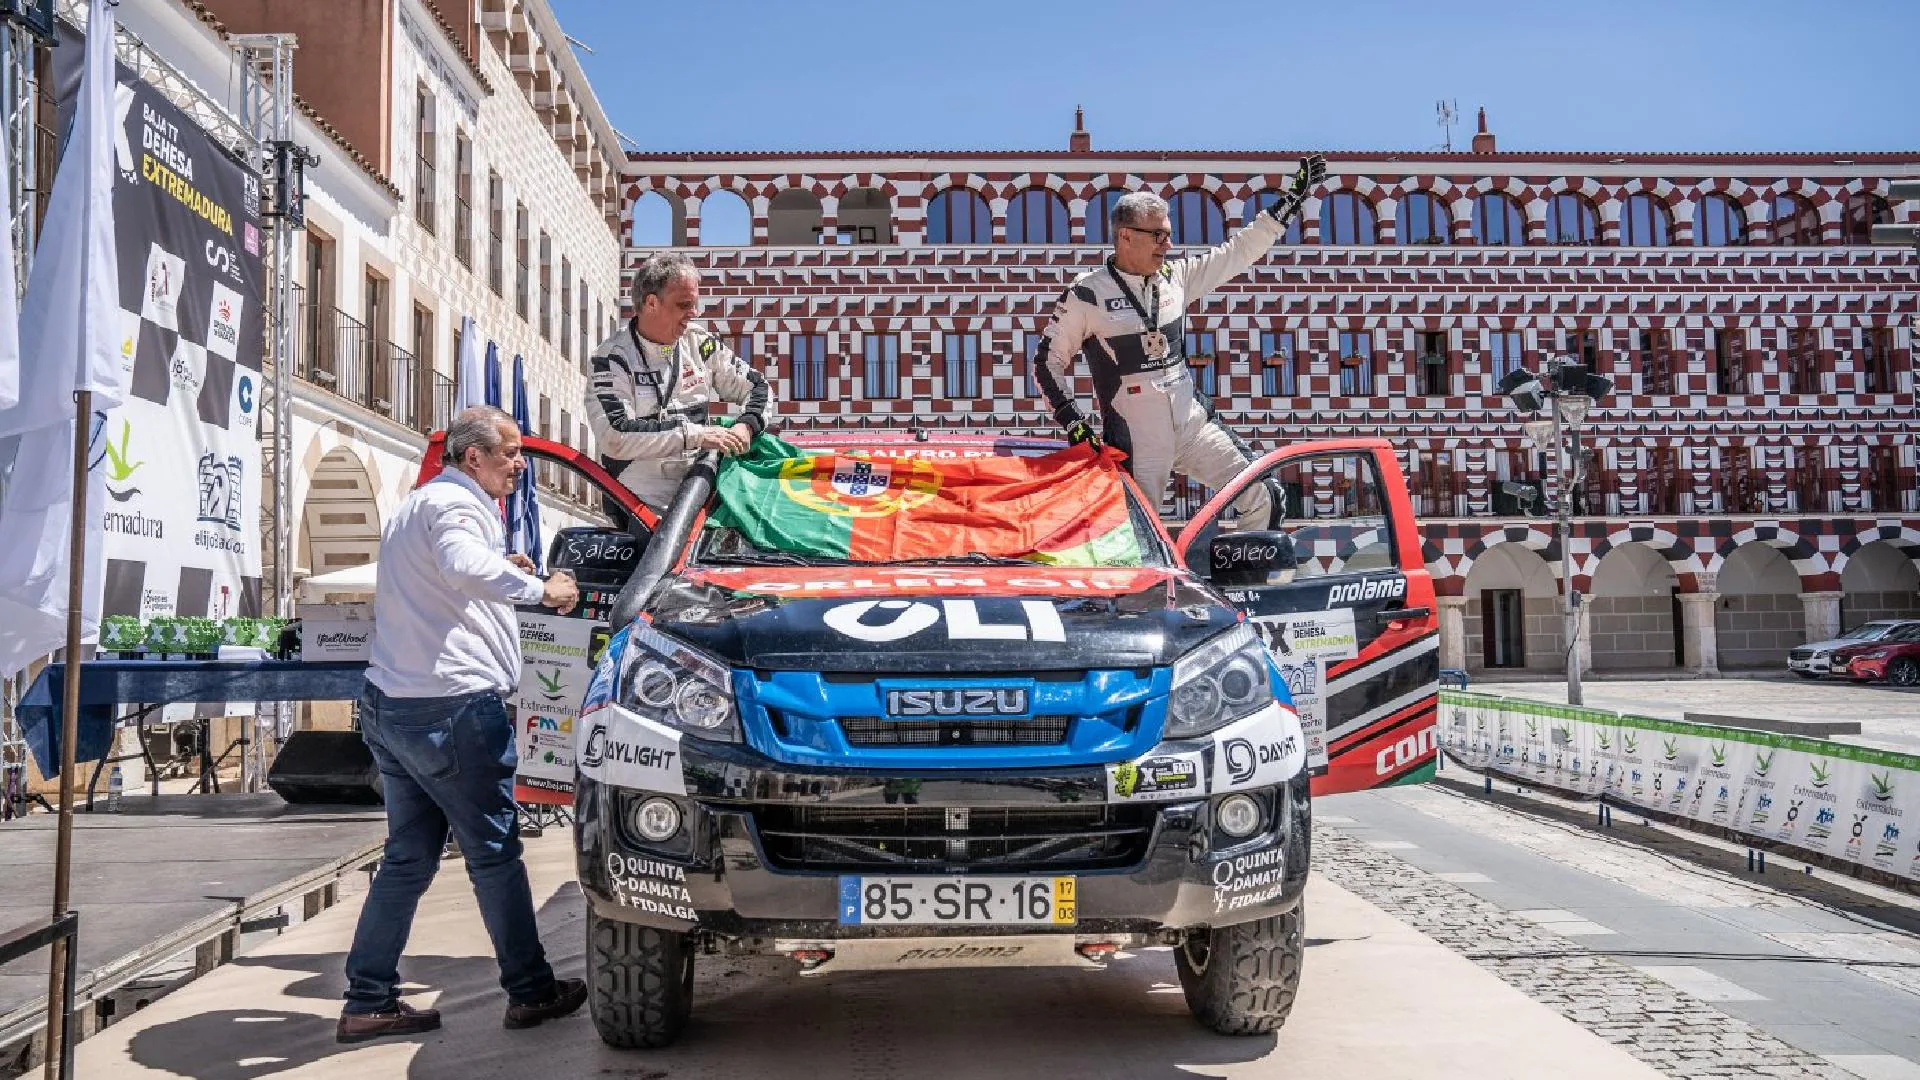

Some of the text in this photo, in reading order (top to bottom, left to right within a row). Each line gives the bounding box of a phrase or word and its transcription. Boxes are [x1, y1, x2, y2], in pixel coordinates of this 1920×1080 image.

[143, 102, 179, 144] BAJA TT
[142, 123, 193, 182] DEHESA
[142, 153, 233, 236] EXTREMADURA
[568, 538, 634, 565] Salero
[1213, 543, 1278, 569] Salero
[1327, 577, 1406, 610] prolama
[823, 599, 1067, 642] OLI
[1293, 627, 1326, 639] DEHESA
[519, 629, 555, 643] DEHESA
[520, 697, 579, 717] Extremadur
[888, 690, 1027, 715] ISUZU
[626, 857, 687, 882] QUINTA
[1235, 848, 1283, 872] QUINTA
[628, 877, 692, 903] DAMATA
[1059, 882, 1073, 896] 17
[1233, 867, 1283, 892] DAMATA
[630, 895, 700, 922] FIDALGA
[1229, 884, 1283, 910] FIDALGA
[1058, 907, 1075, 920] 03
